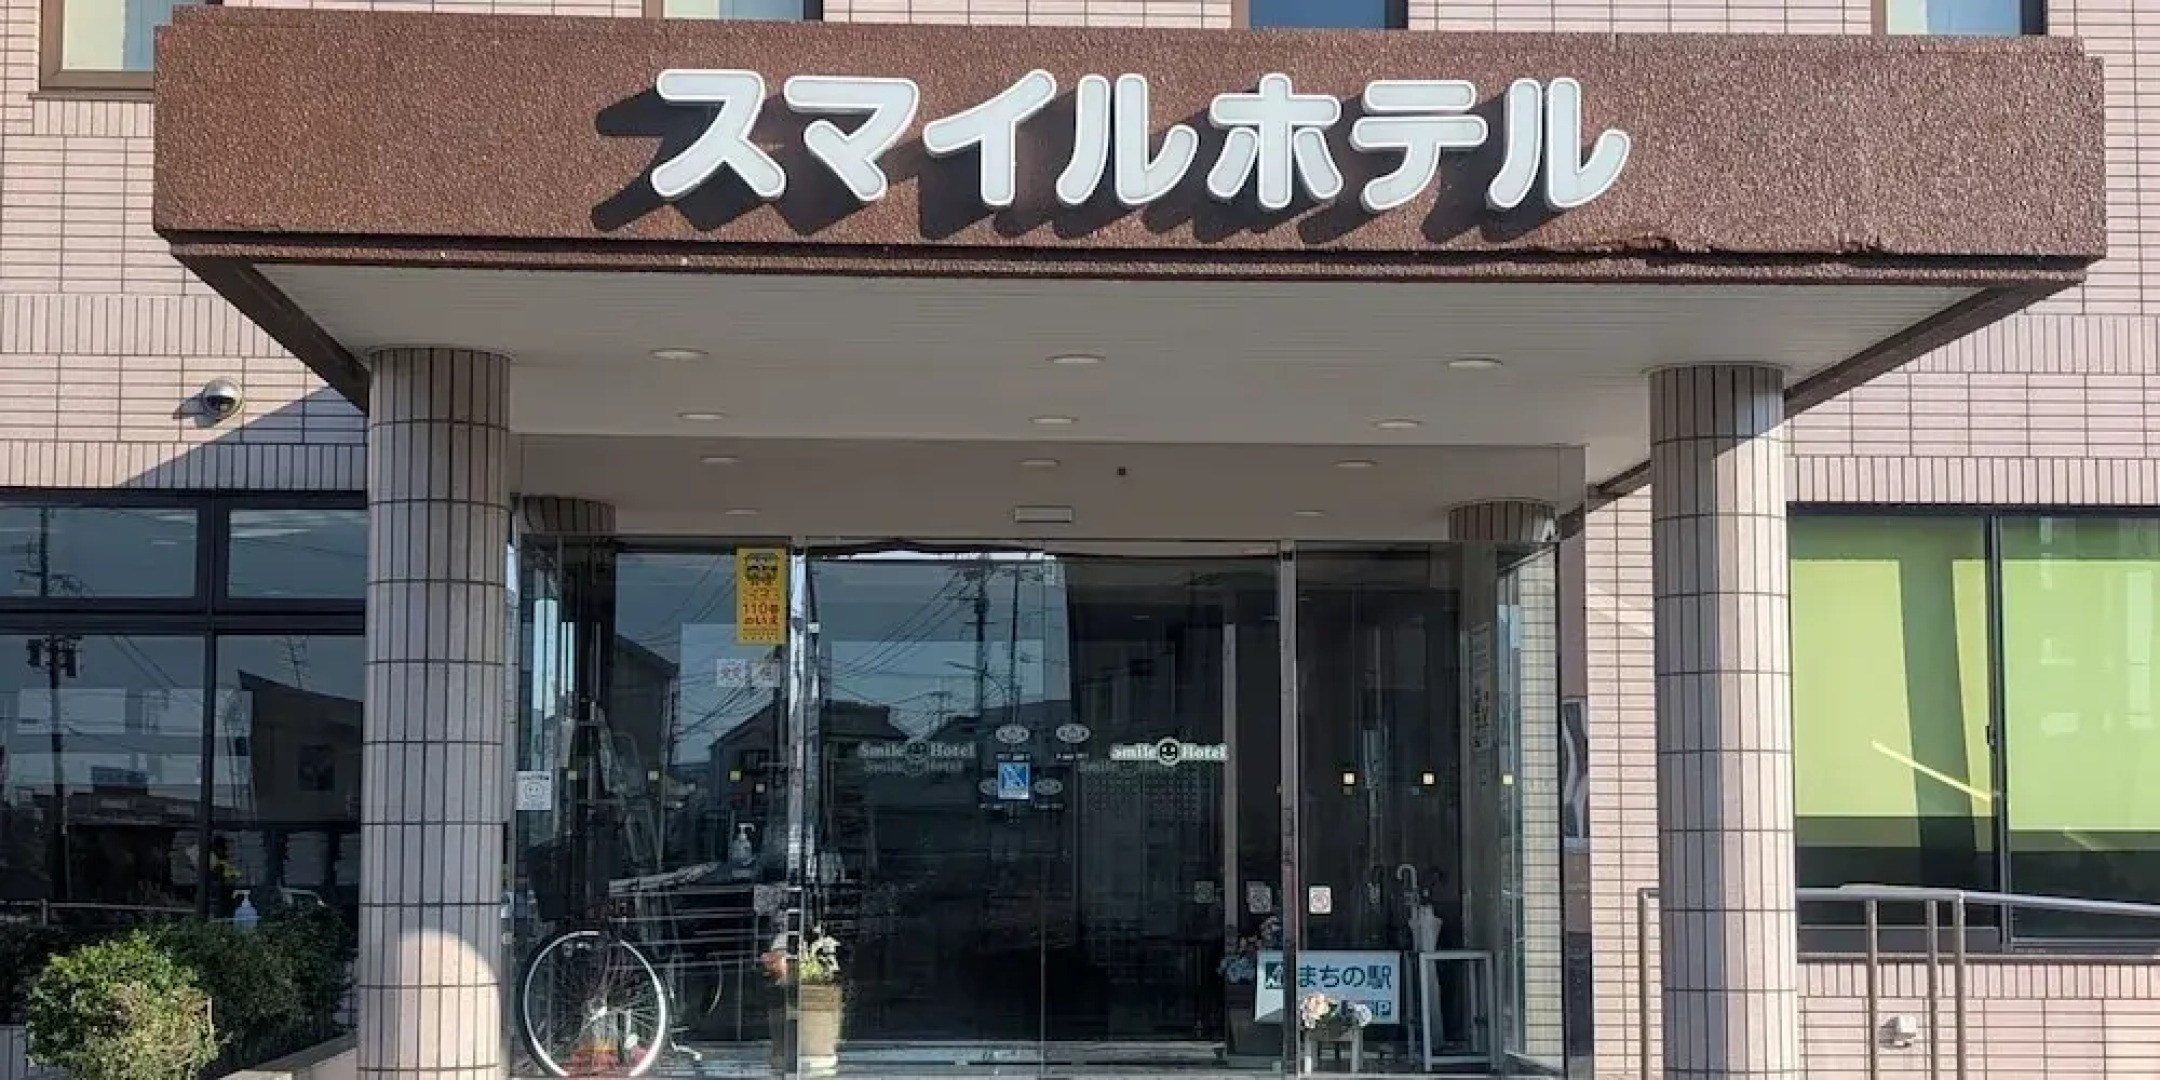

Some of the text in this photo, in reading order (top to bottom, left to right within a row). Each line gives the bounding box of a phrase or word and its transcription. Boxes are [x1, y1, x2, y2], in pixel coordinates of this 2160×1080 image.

[650, 68, 1631, 212] スマイルホテル
[1180, 743, 1228, 760] Hotel
[1298, 963, 1392, 989] まちの駅
